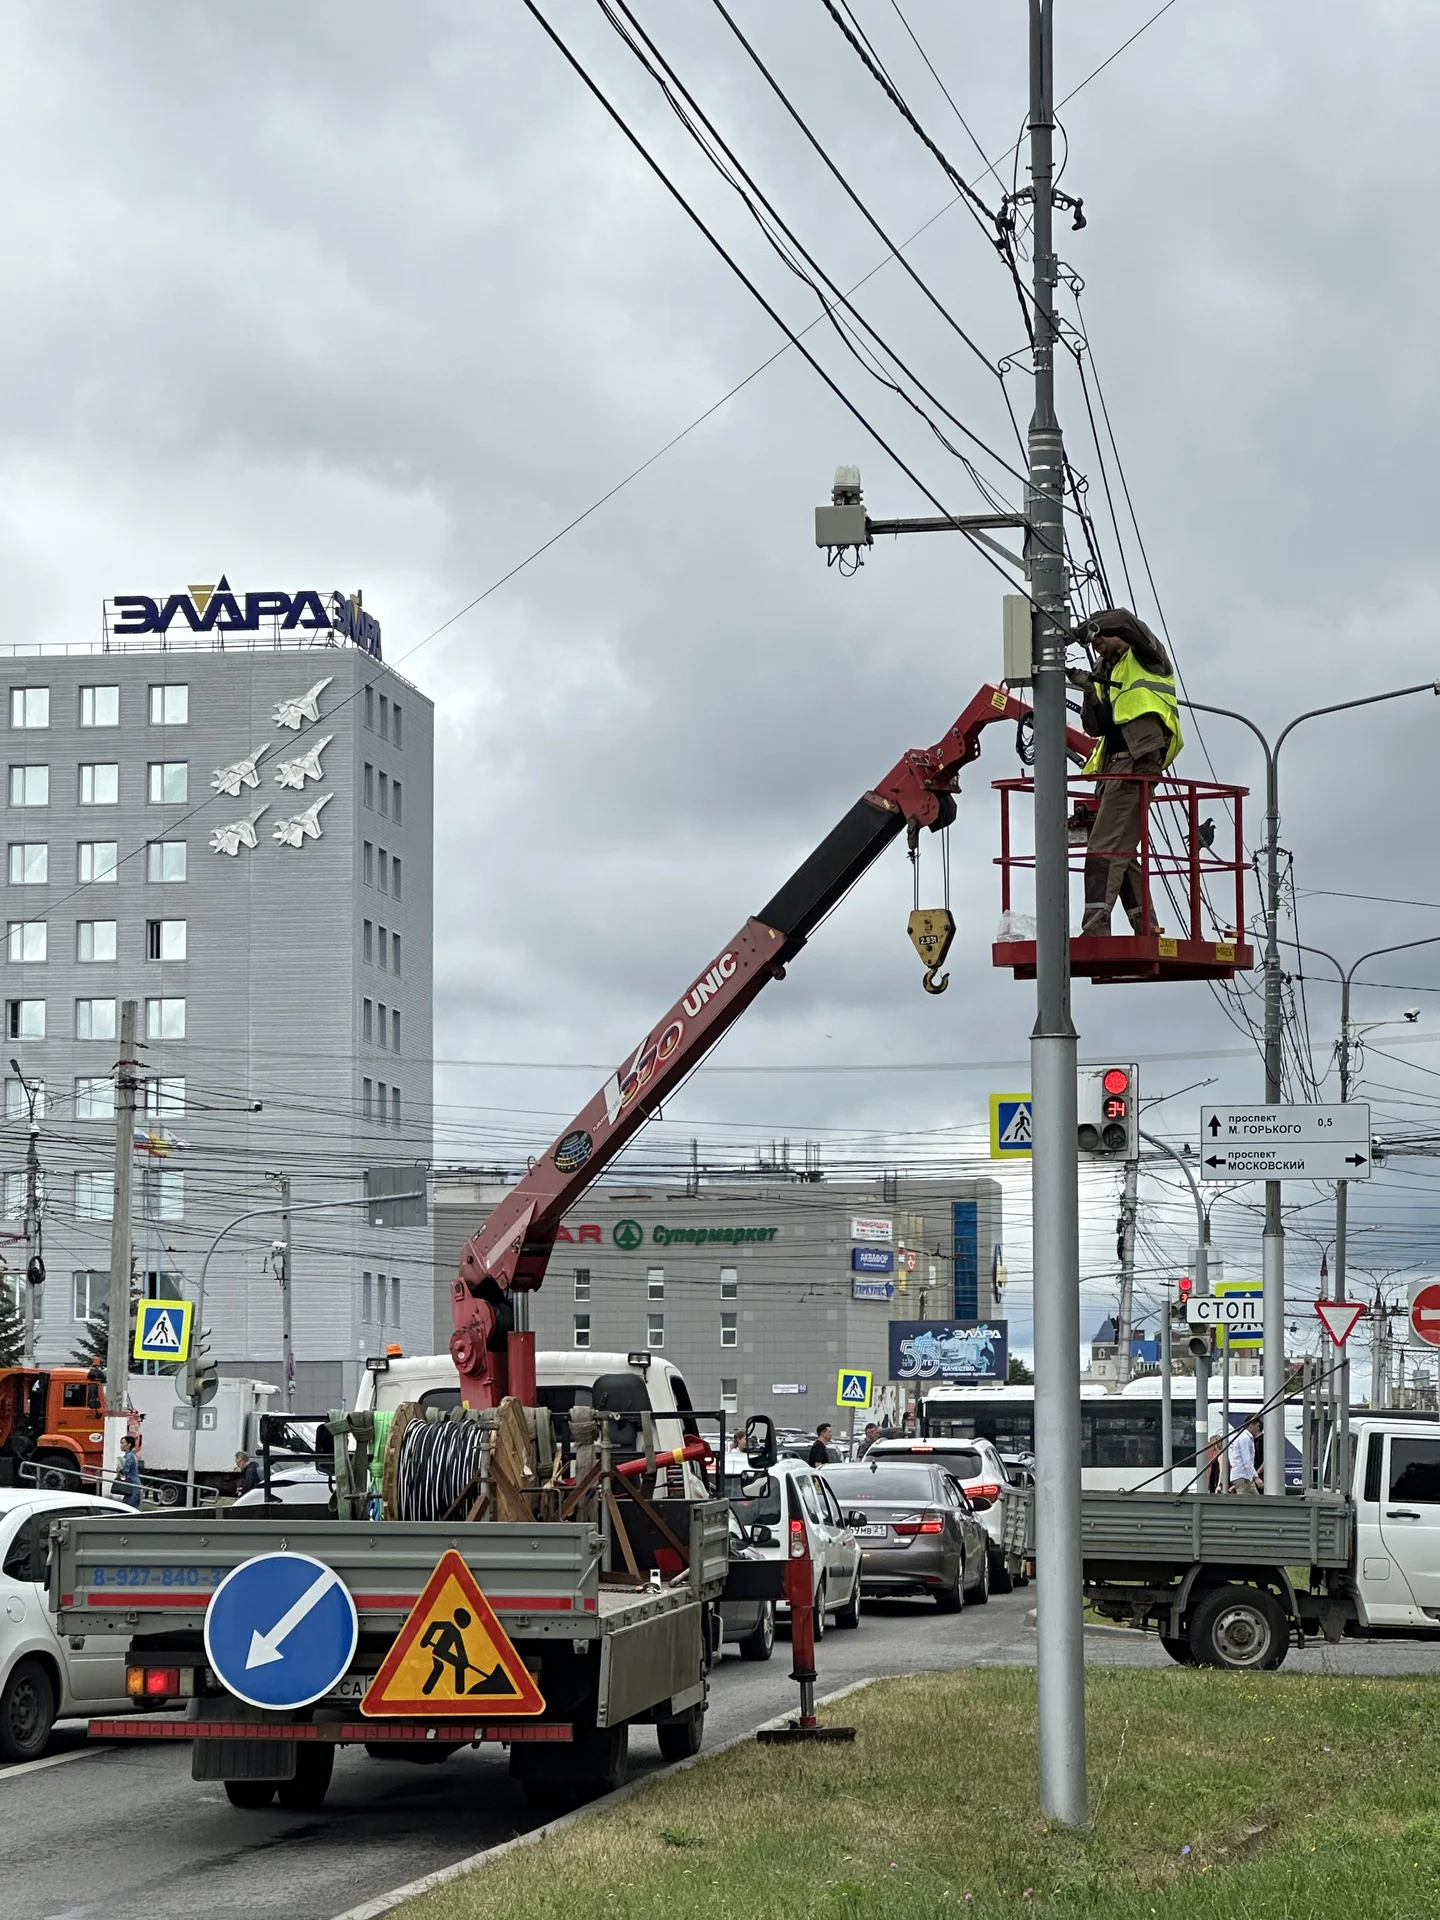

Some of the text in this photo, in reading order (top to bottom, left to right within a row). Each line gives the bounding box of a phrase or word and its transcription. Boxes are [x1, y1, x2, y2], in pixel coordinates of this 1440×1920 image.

[682, 953, 737, 1017] UNIC
[1108, 1101, 1125, 1117] 34
[1228, 1115, 1277, 1124] проспект
[1317, 1118, 1333, 1128] 0,5
[1228, 1125, 1302, 1134] М. ГОРЬКОГО
[1228, 1151, 1276, 1161] проспект
[1228, 1159, 1305, 1170] МОСКОВСКИЙ
[556, 1225, 601, 1243] AR
[652, 1224, 778, 1246] Супермаркет
[1180, 1293, 1188, 1302] 3
[1197, 1301, 1255, 1319] СТОП
[850, 1527, 872, 1535] 59МВ
[94, 1567, 230, 1586] 8-927-840-3
